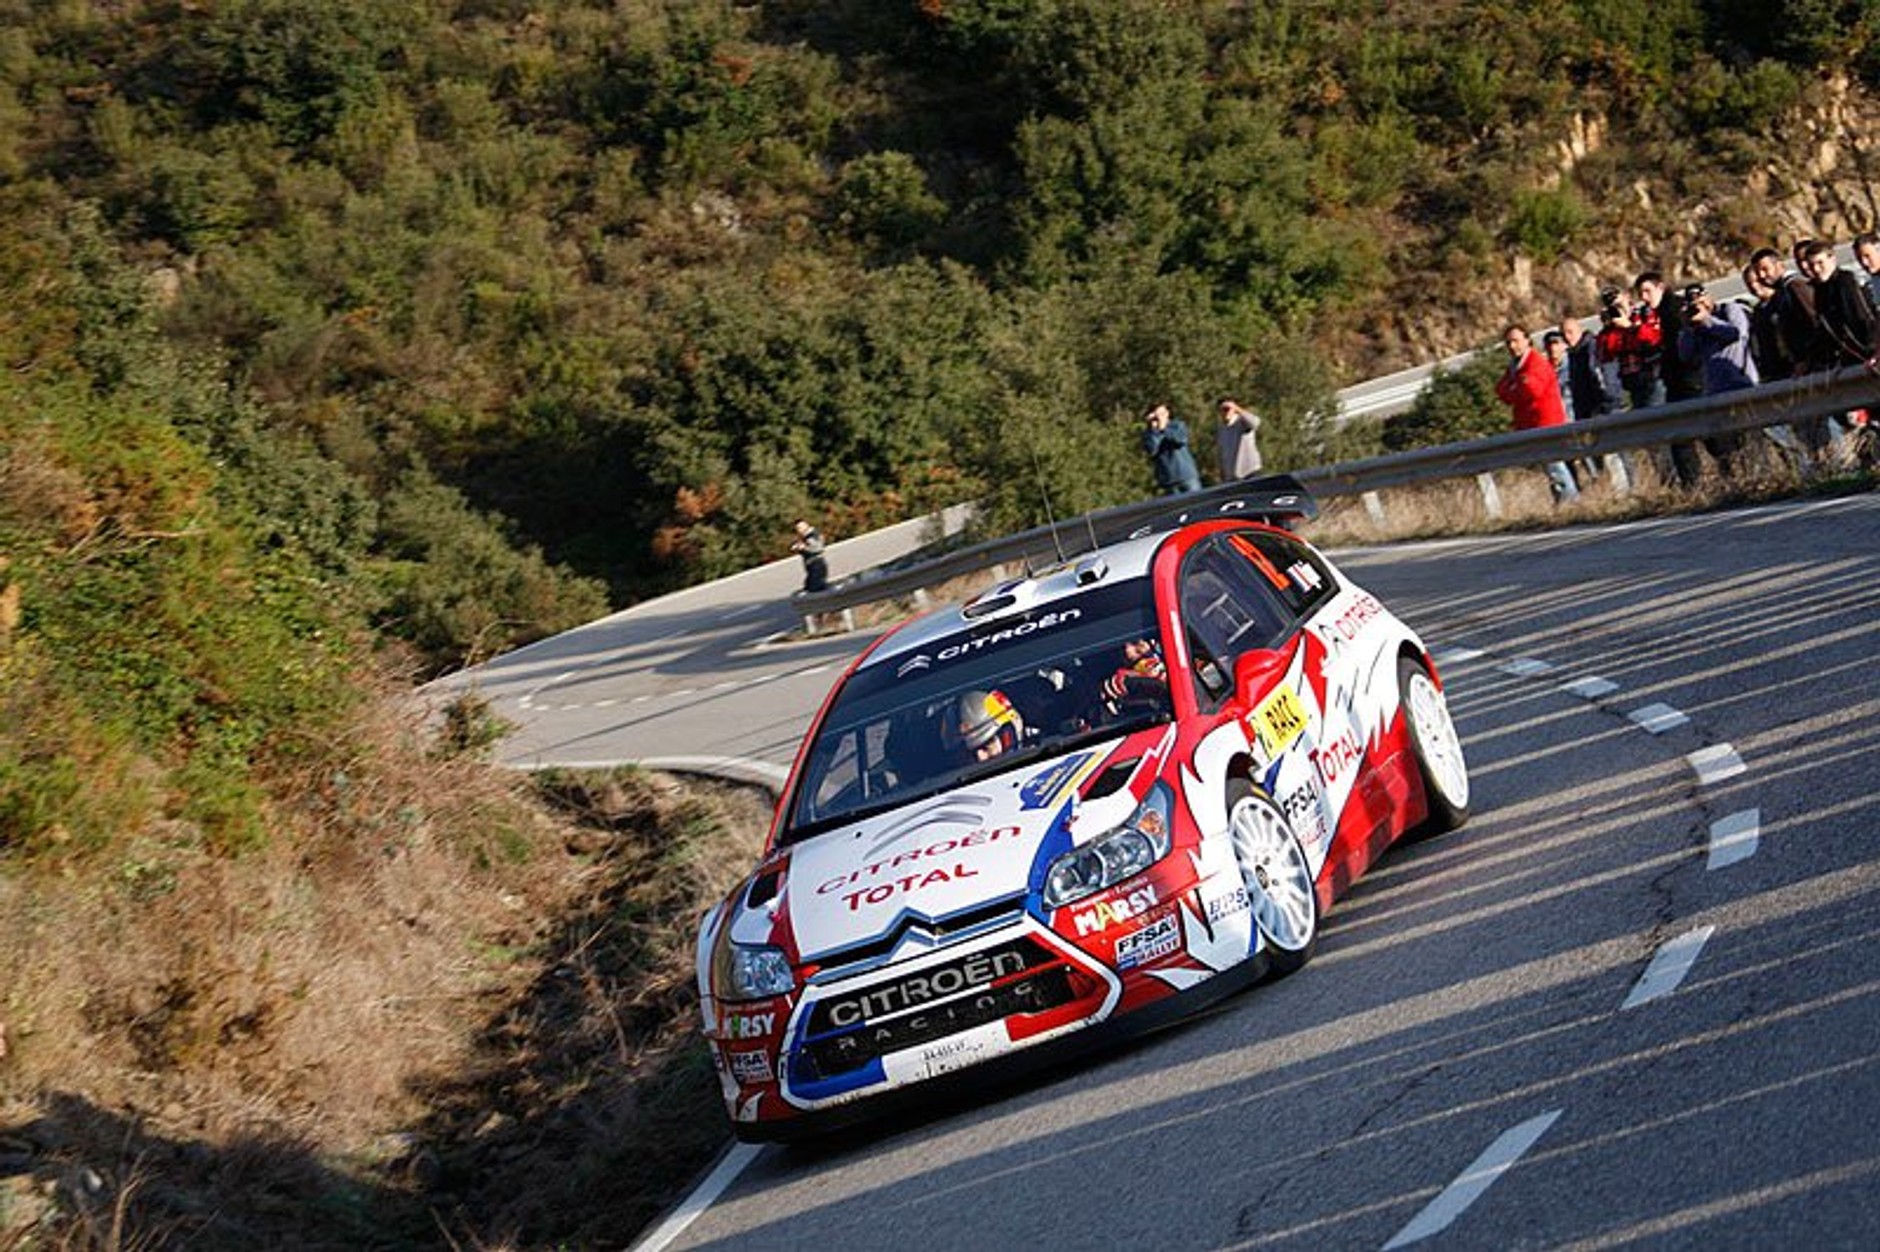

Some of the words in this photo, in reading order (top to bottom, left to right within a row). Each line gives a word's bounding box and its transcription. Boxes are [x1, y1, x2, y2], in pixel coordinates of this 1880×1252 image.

[1307, 728, 1364, 788] TOTAL
[841, 863, 979, 911] TOTAL
[1073, 883, 1159, 937] MARSY
[1117, 920, 1172, 953] FFSA
